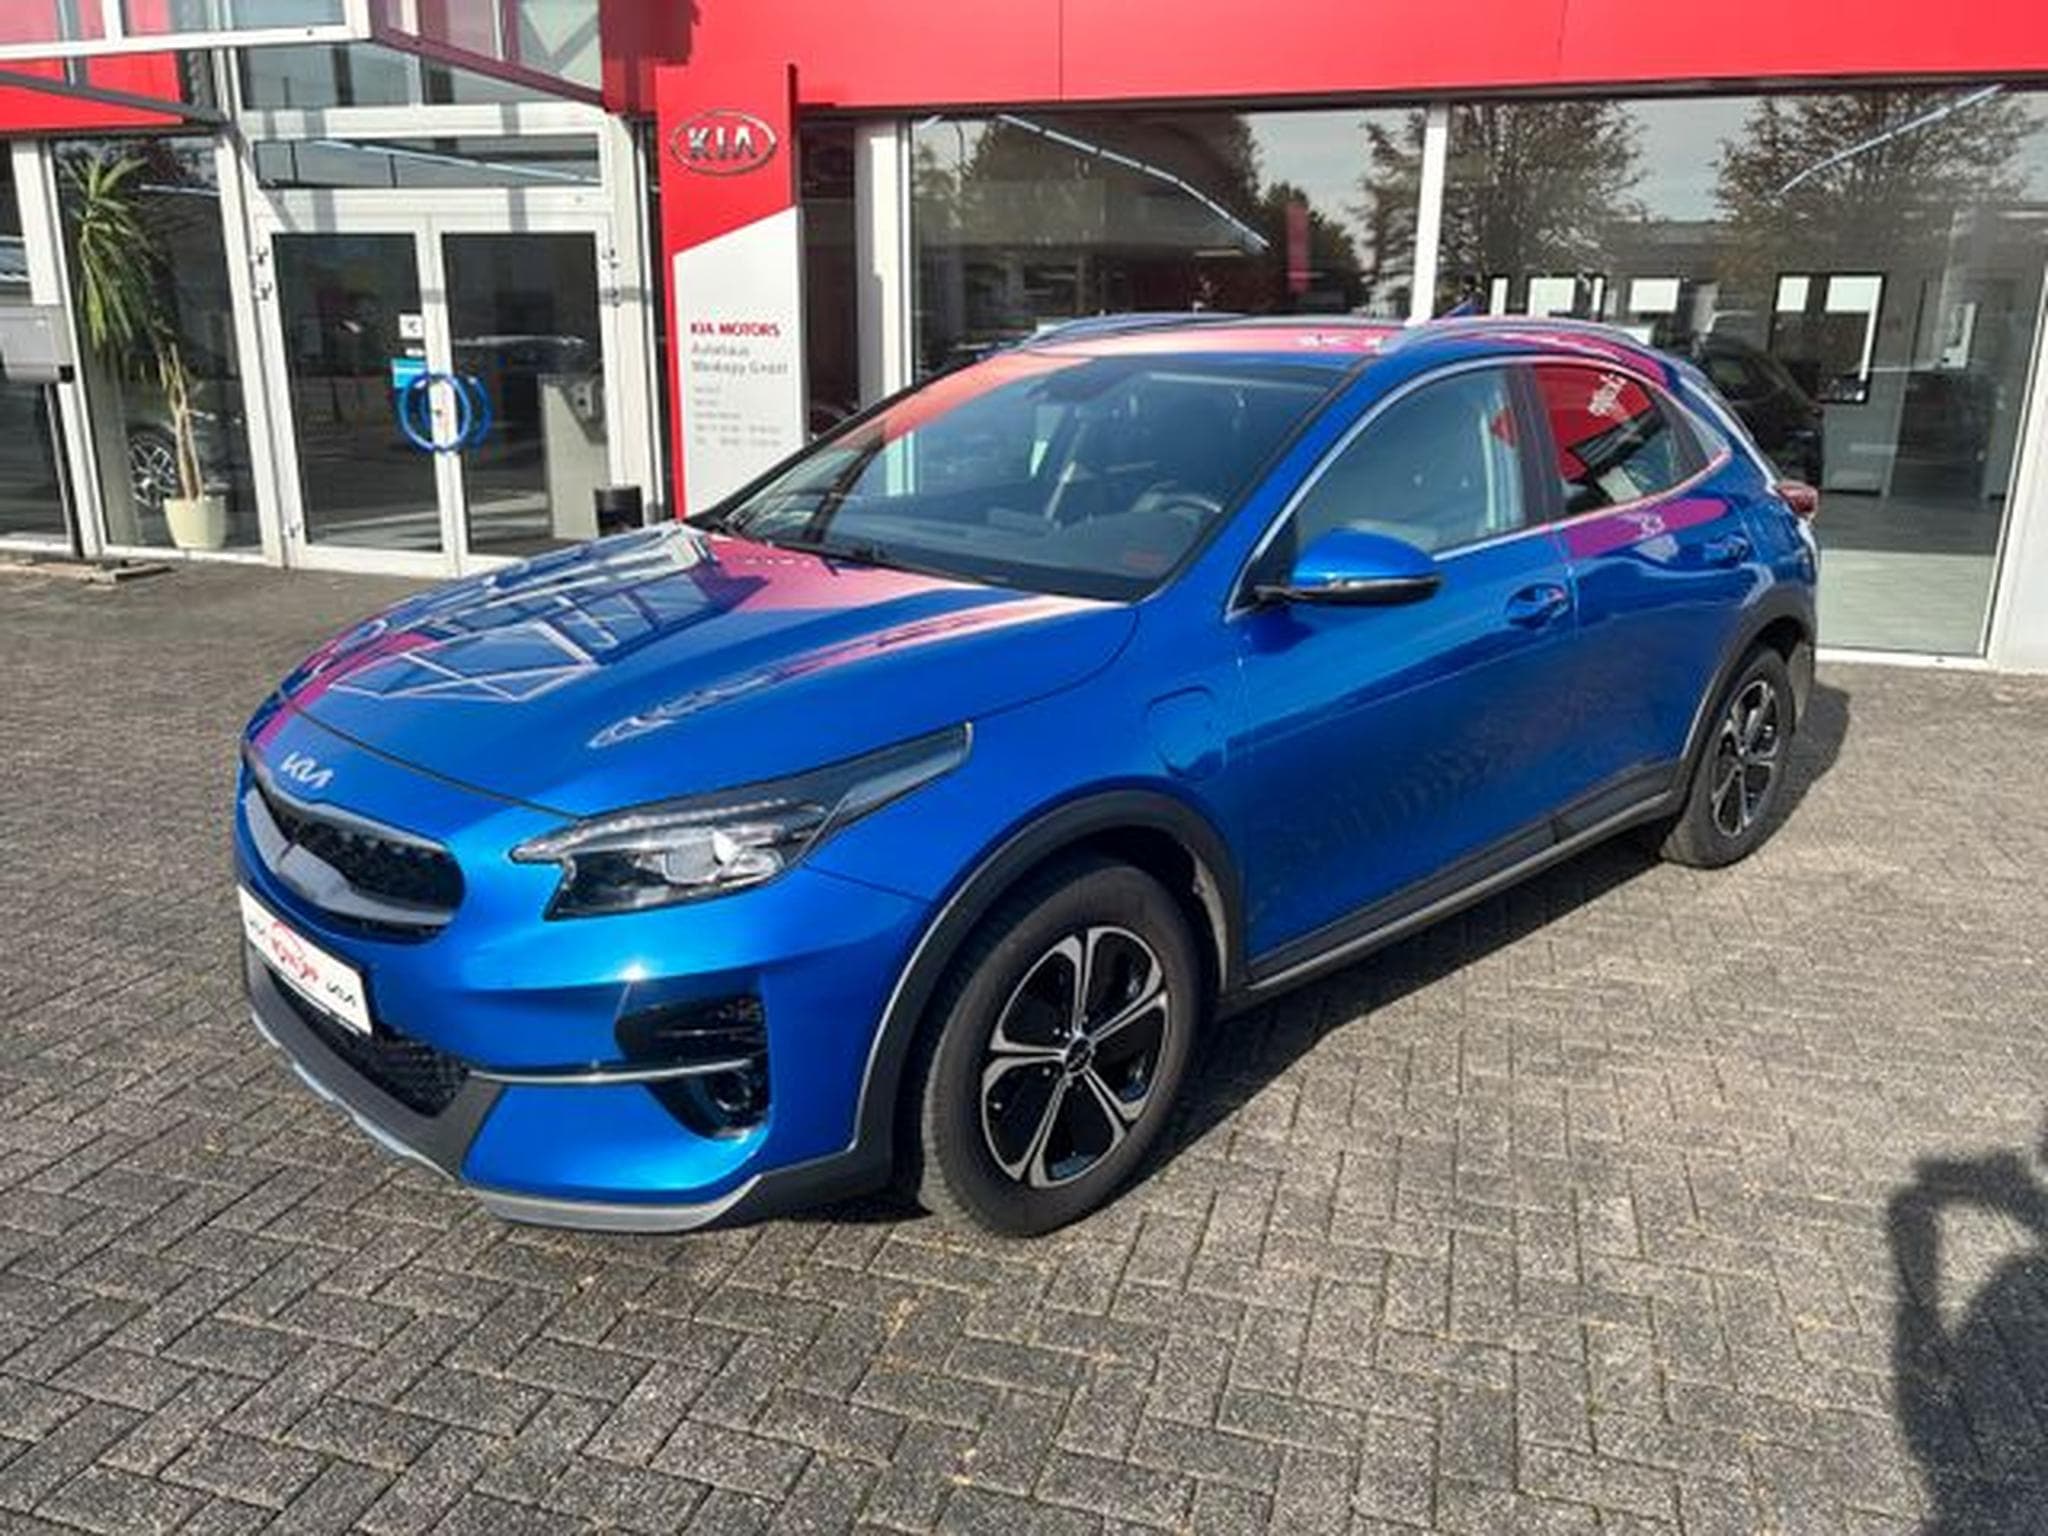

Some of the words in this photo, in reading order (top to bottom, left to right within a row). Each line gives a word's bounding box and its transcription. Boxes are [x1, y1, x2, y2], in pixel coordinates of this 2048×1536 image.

[688, 127, 756, 159] KIA
[691, 323, 714, 335] KIA
[719, 323, 780, 338] MOTORS
[280, 751, 333, 788] KIA
